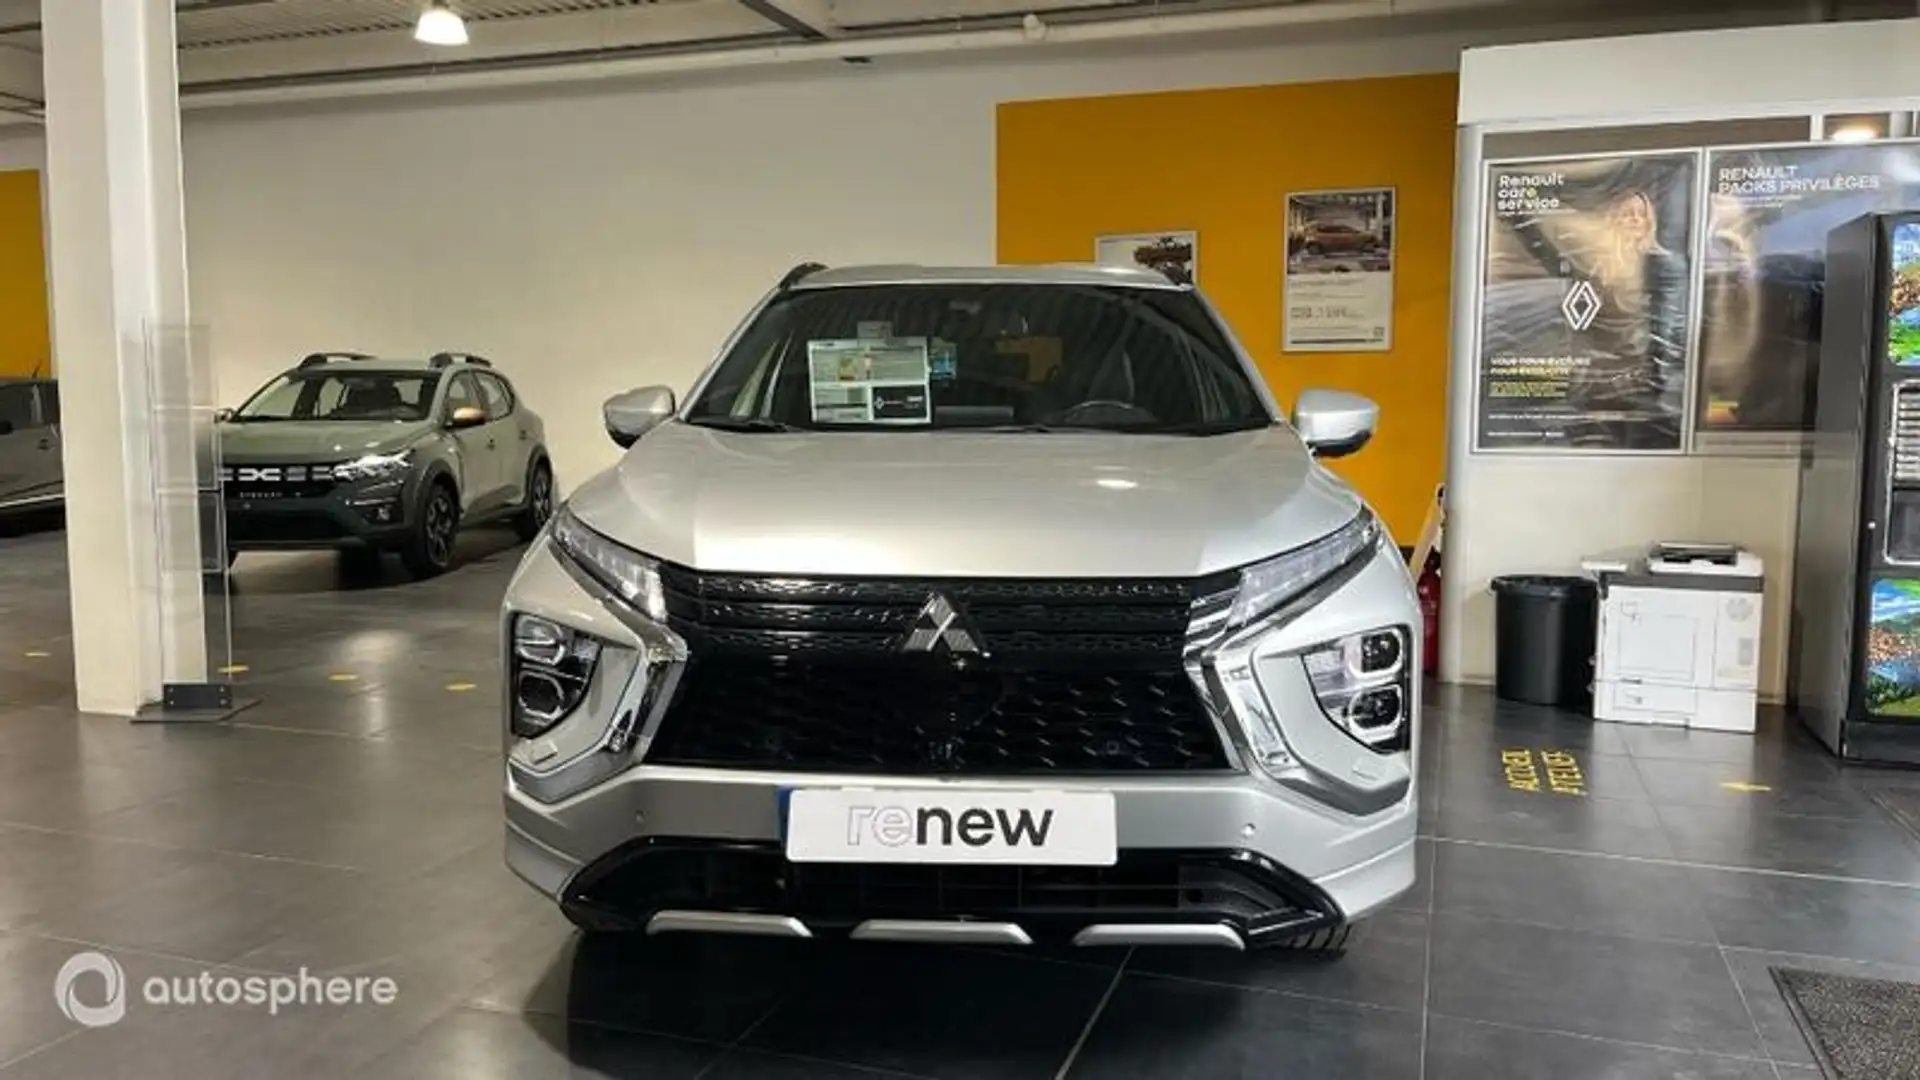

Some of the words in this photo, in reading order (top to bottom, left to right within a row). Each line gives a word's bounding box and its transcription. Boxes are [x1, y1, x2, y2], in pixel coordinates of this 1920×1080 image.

[1500, 173, 1564, 187] Renault
[1719, 166, 1797, 181] RENAULT
[1719, 180, 1777, 194] PACKS
[1780, 174, 1879, 193] PRIVILÈGES
[1498, 187, 1537, 198] care
[1498, 198, 1559, 209] service
[847, 804, 1055, 847] renew
